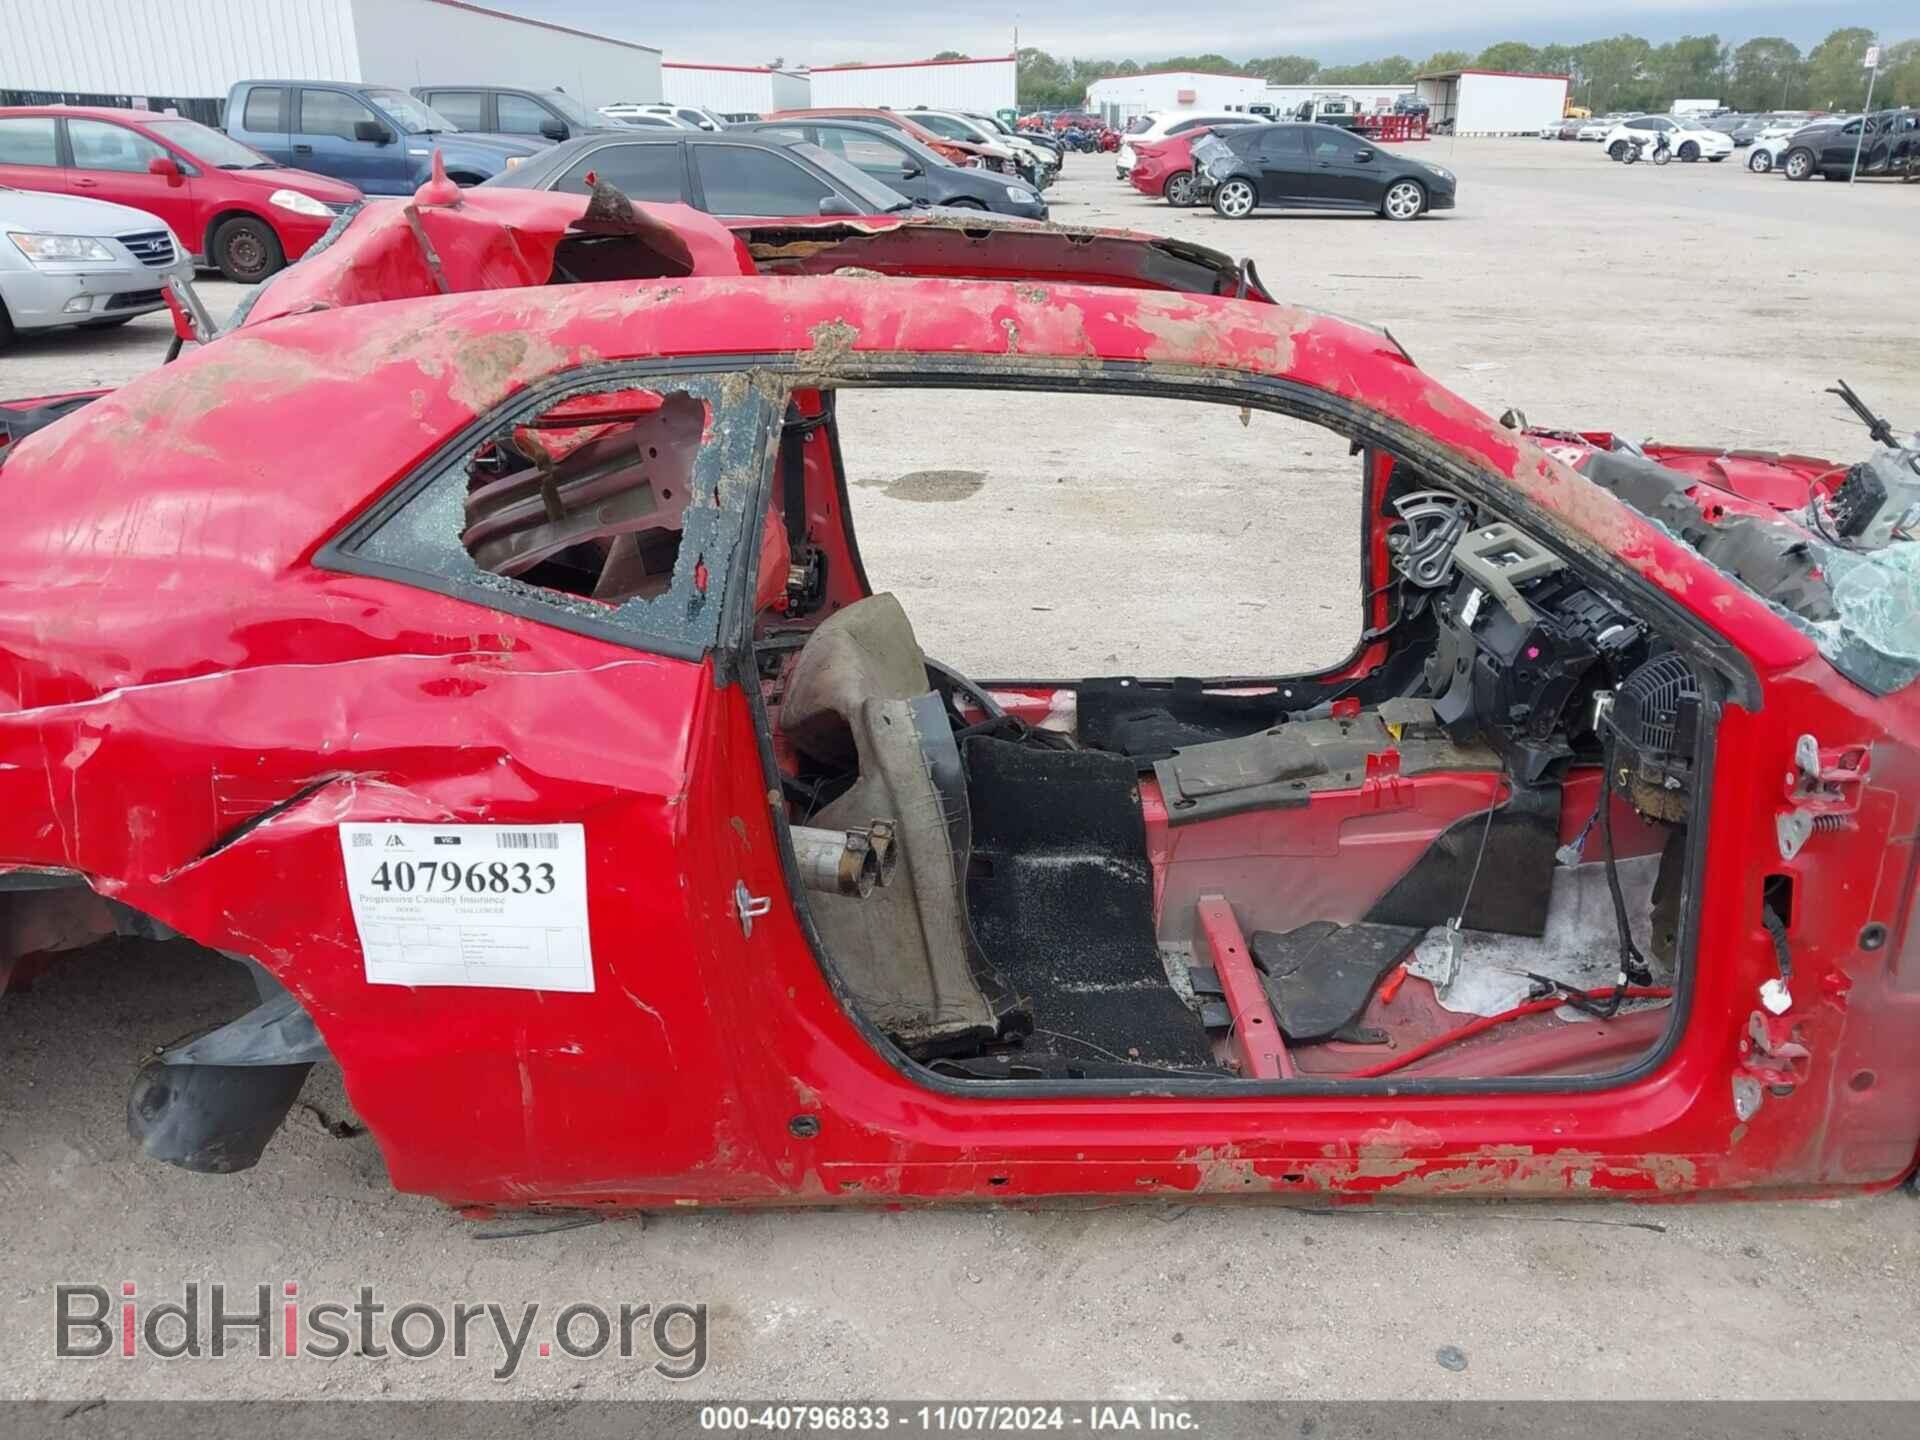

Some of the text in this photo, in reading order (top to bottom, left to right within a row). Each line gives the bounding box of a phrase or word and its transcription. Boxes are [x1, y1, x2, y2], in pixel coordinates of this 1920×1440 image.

[371, 861, 556, 894] 40796833
[359, 894, 505, 906] Progressive Casualty Insurance
